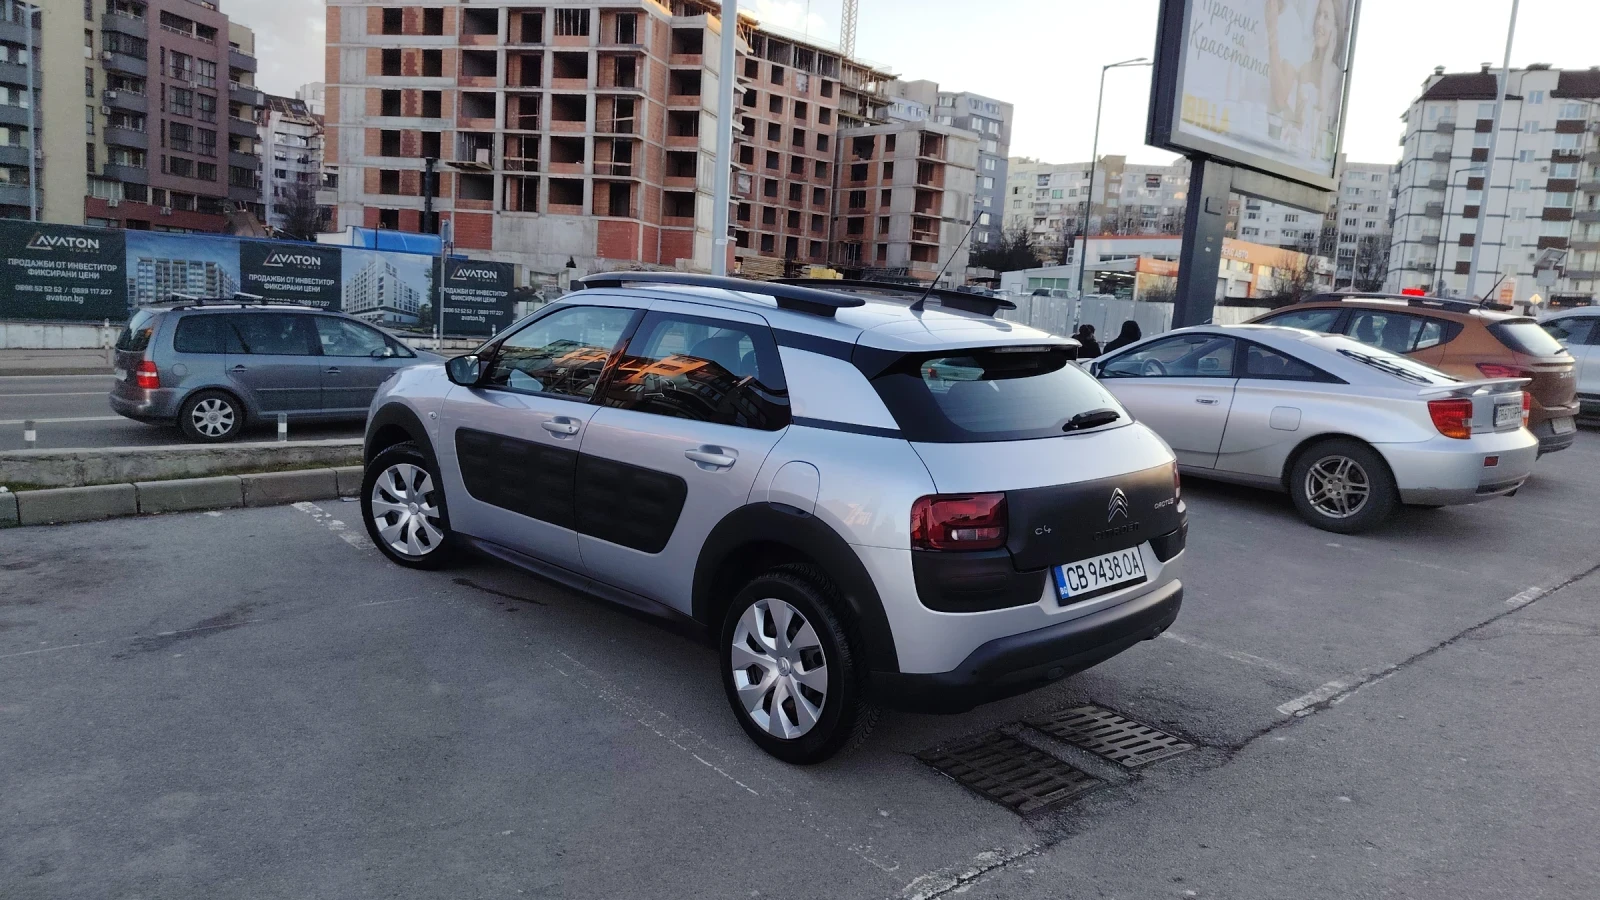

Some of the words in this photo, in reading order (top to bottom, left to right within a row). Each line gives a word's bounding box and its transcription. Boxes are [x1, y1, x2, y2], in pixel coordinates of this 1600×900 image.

[1232, 33, 1245, 47] на
[1190, 18, 1269, 77] Красотата
[37, 236, 99, 248] AVATON
[8, 258, 54, 268] ПРОДАЖБИ
[68, 262, 117, 271] ИНВЕСТИТОР
[271, 254, 320, 265] AVATON
[28, 269, 77, 278] ФИКСИРАНИ
[457, 269, 497, 278] AVATON
[249, 274, 285, 282] ПРОДАЖБИ
[295, 277, 334, 286] ИНВЕСТИТОР
[264, 283, 303, 291] ФИКСИРАНИ
[46, 295, 84, 304] avaton.bg
[1035, 525, 1052, 535] C4
[1066, 564, 1088, 591] CB
[1088, 556, 1123, 586] 9438
[1122, 551, 1141, 576] OA
[1060, 586, 1068, 595] BG
